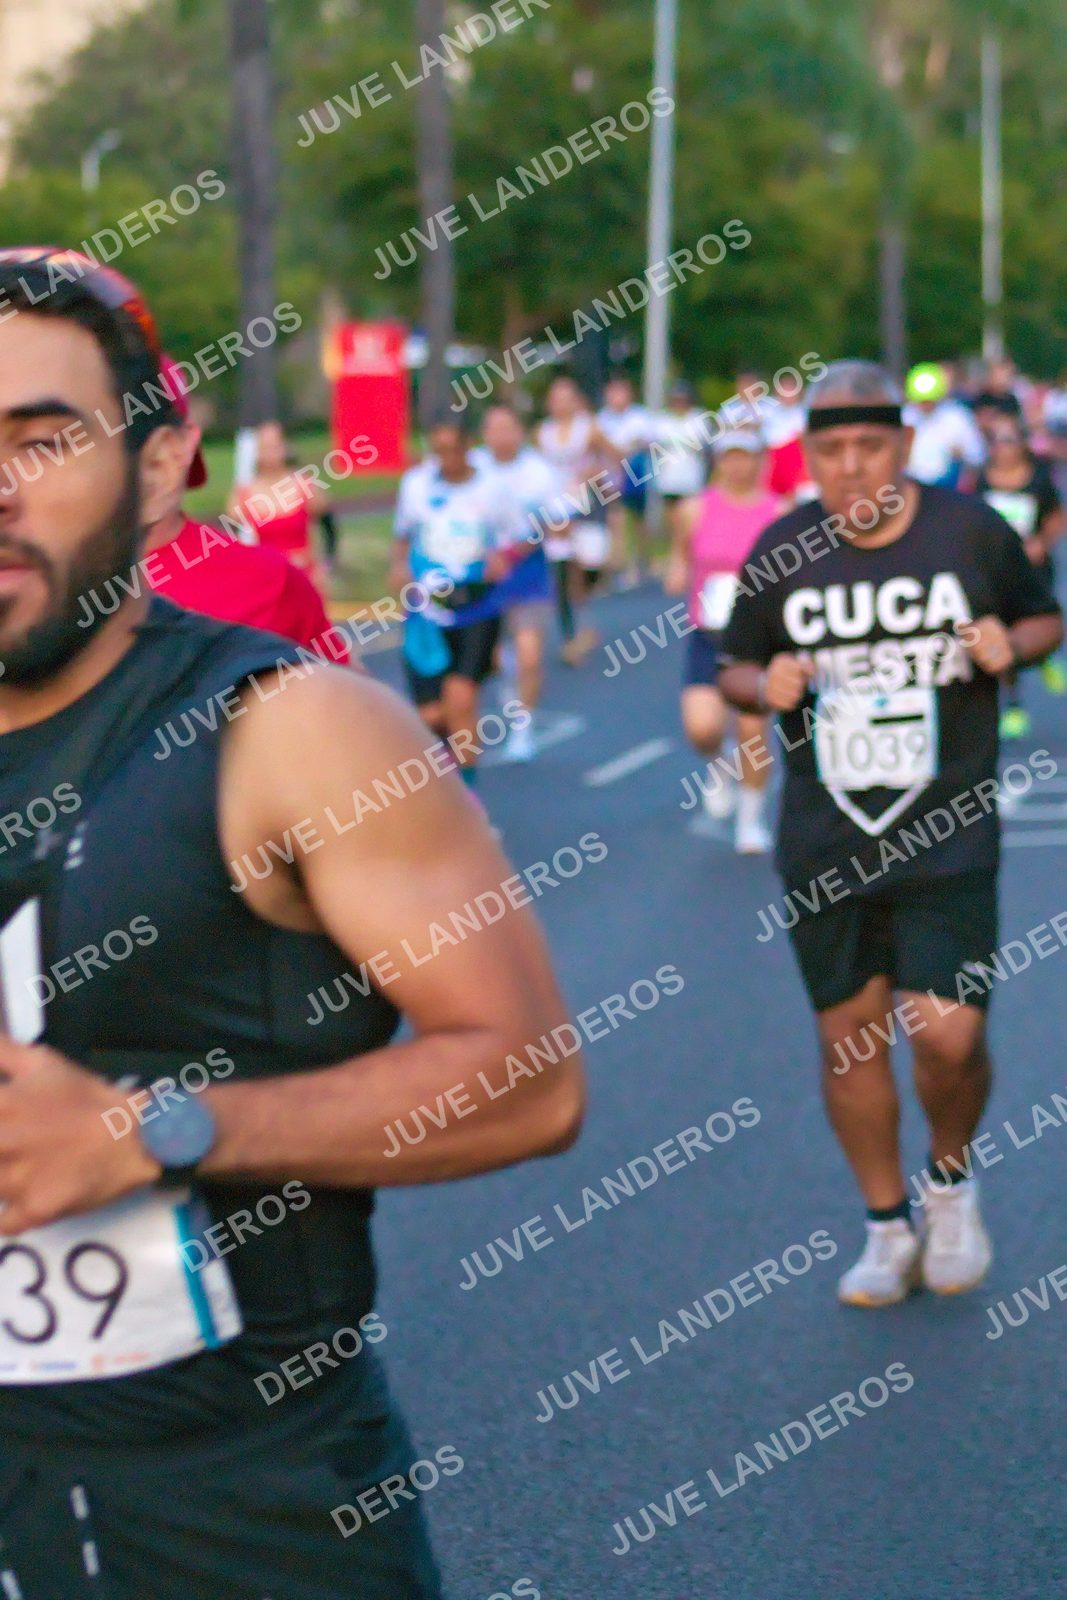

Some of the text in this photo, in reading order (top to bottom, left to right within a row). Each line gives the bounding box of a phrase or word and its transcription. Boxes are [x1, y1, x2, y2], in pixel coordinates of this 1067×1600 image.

[783, 572, 973, 645] CUCA
[796, 635, 973, 690] IESTA
[826, 729, 930, 772] 1039
[0, 1240, 128, 1346] 39
